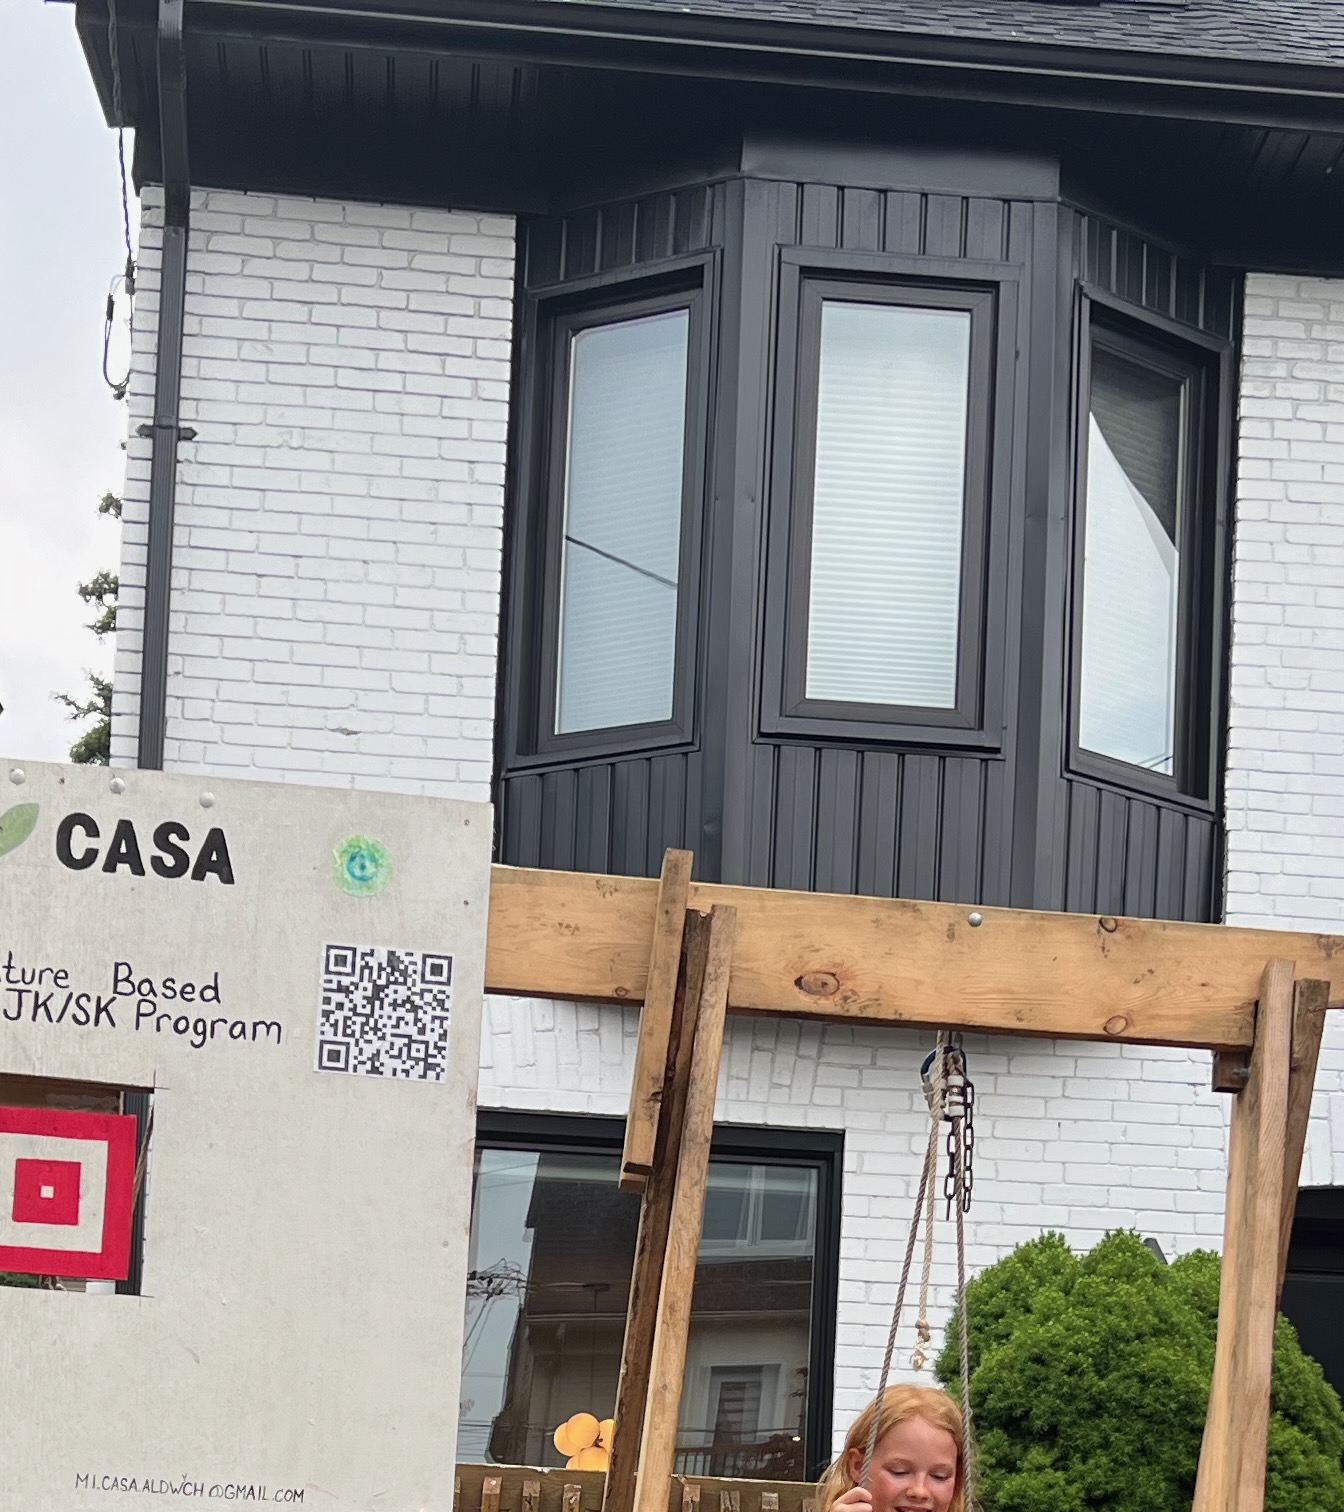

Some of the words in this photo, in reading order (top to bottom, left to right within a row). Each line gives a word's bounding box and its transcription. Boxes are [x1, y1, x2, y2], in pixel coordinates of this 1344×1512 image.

[55, 812, 235, 885] CASA
[112, 961, 222, 1004] Based
[2, 987, 117, 1029] JK/SK
[134, 998, 282, 1049] Program
